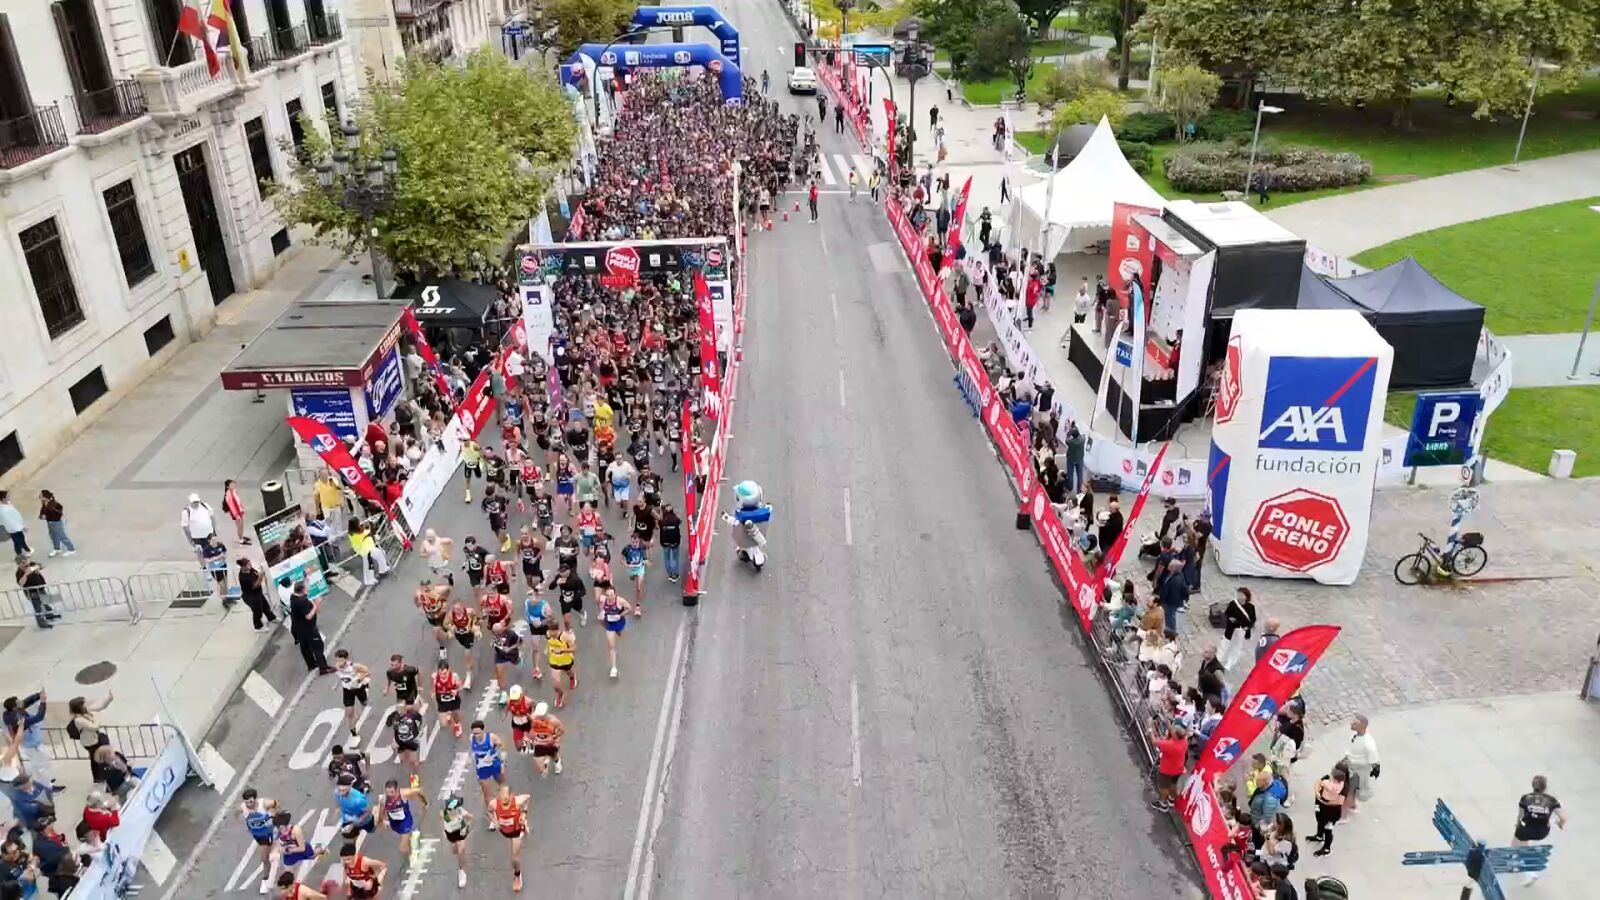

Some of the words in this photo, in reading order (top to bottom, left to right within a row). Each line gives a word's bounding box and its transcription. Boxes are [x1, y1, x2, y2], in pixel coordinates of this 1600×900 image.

[274, 372, 344, 383] TABACOS
[1260, 405, 1347, 443] AXA
[1428, 402, 1461, 437] P
[1256, 454, 1361, 474] fundación
[1261, 523, 1329, 554] FRENO
[1268, 508, 1337, 540] PONLE
